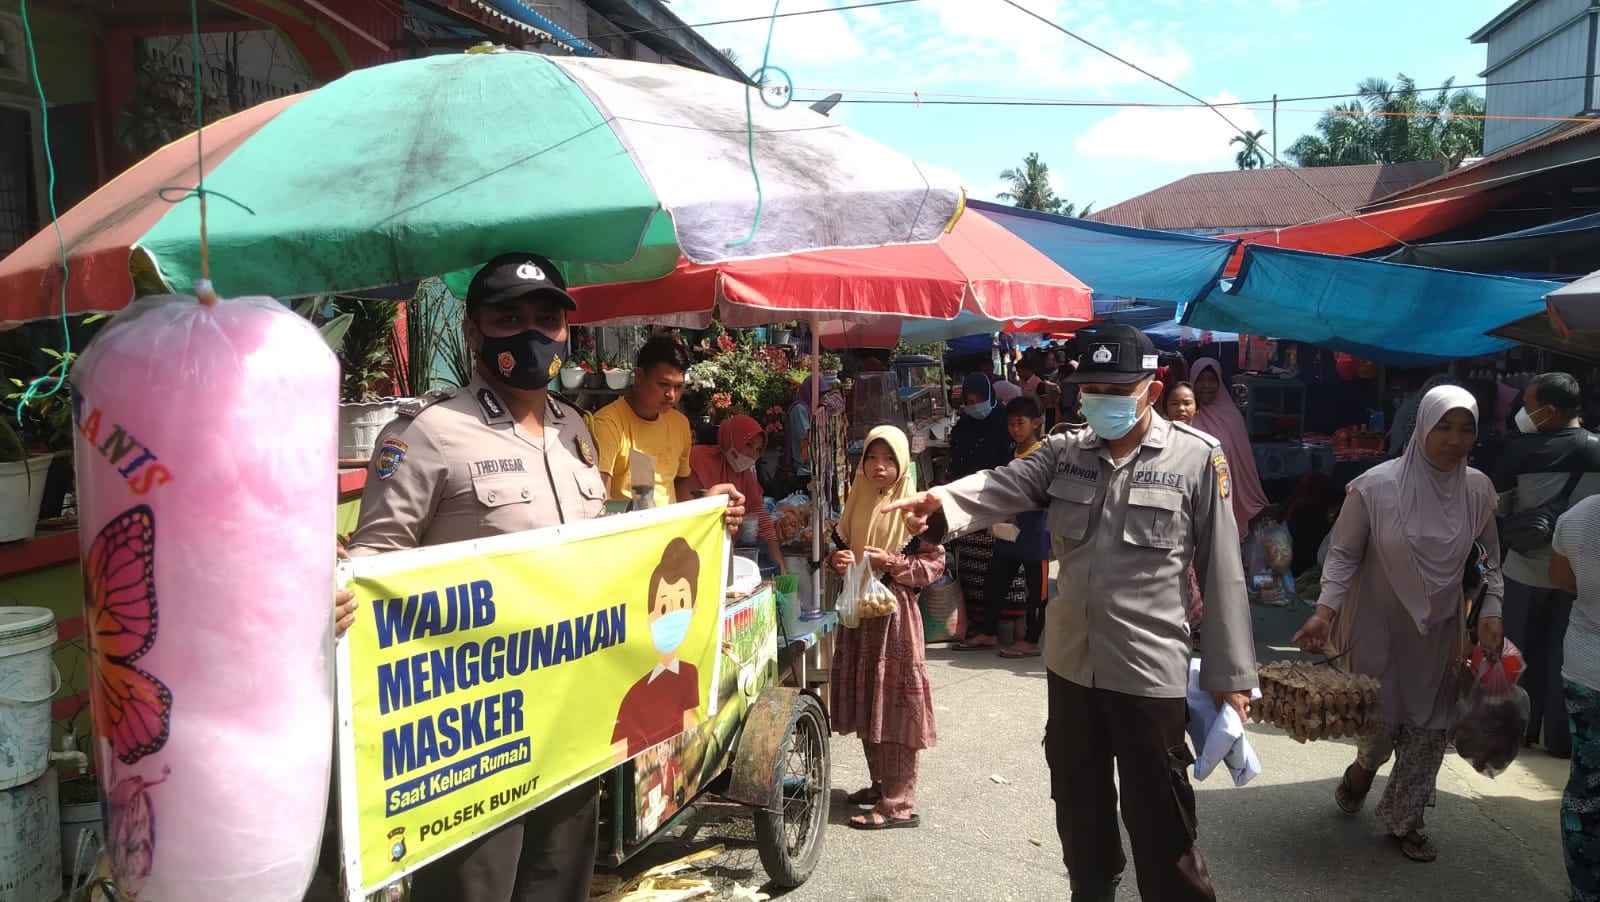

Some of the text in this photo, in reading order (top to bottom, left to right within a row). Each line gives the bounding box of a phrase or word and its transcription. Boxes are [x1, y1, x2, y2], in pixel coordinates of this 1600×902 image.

[1135, 470, 1185, 487] POLISI
[373, 579, 496, 649] WAJIB
[377, 603, 627, 715] MENGGUNAKAN
[383, 689, 524, 781] MASKER
[389, 742, 529, 812] Saat Keluar Rumah
[420, 775, 540, 842] POLSEK BUNUT
